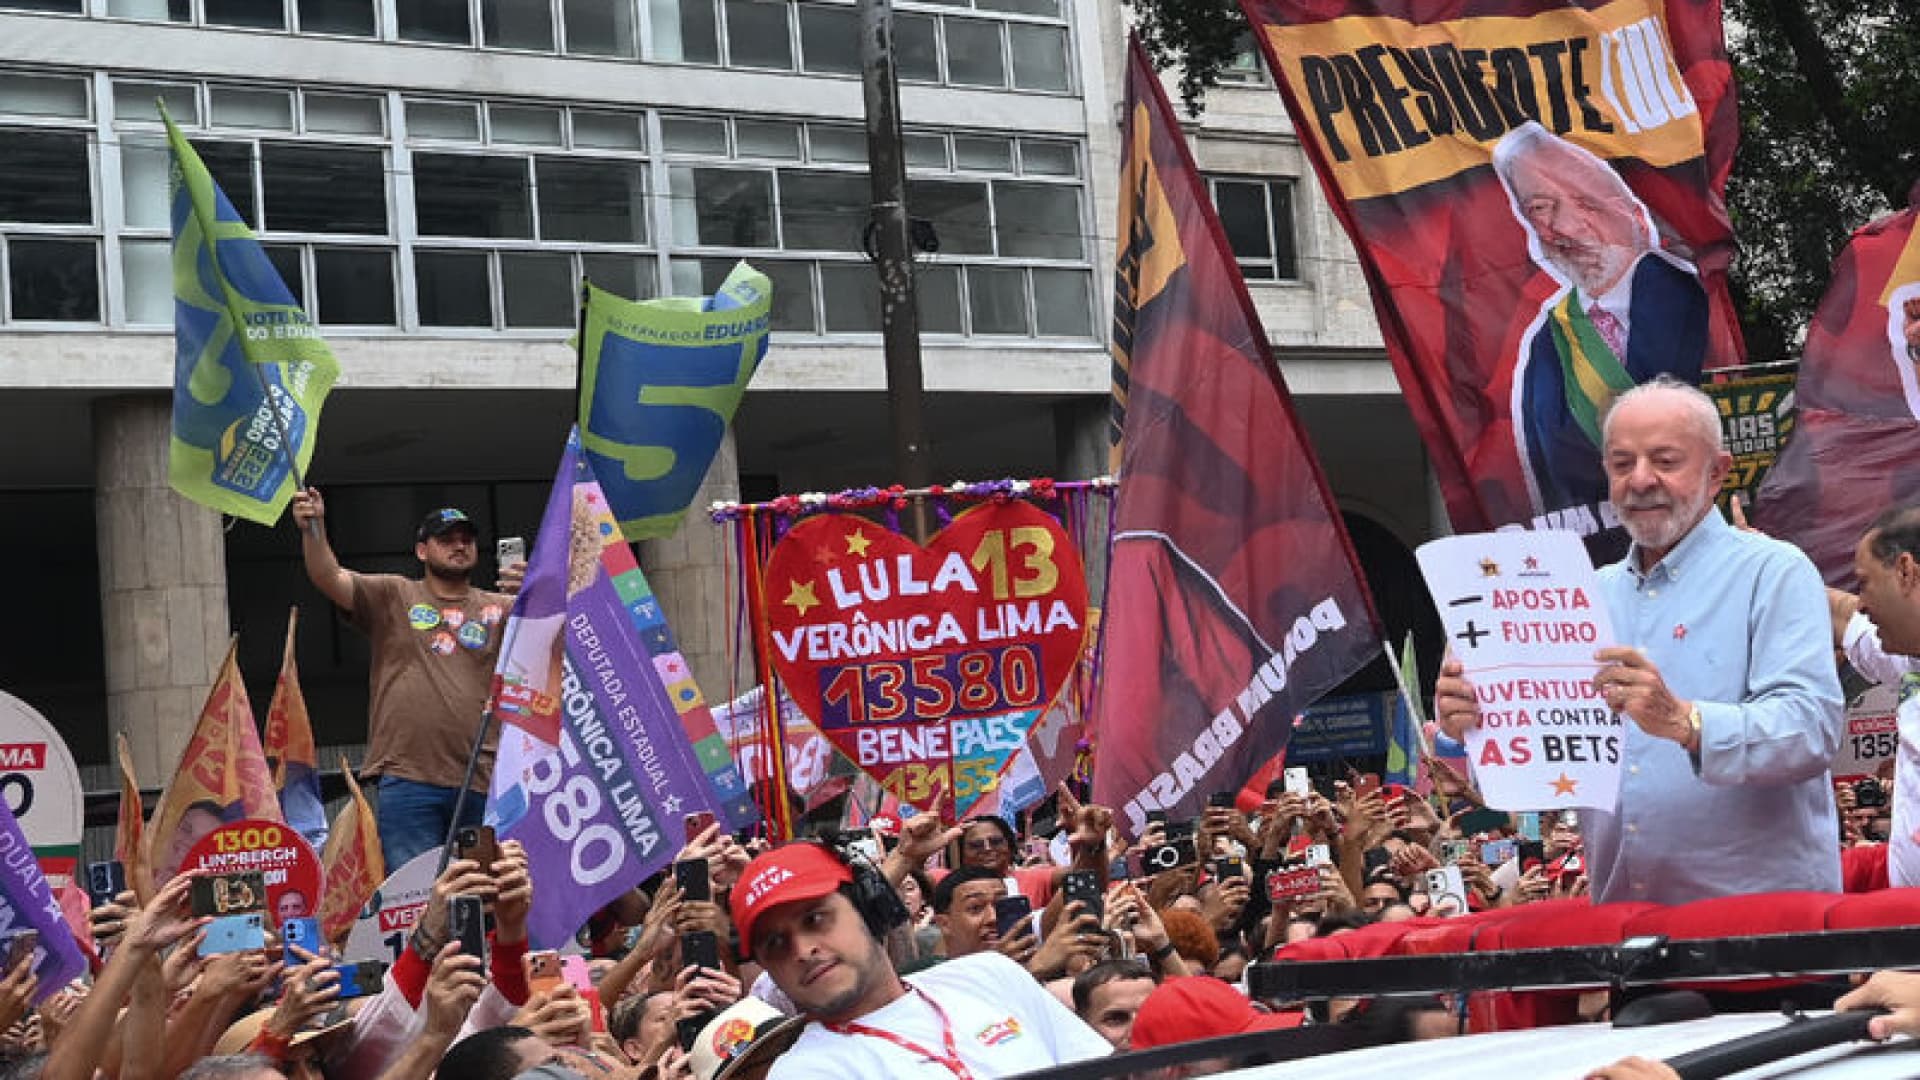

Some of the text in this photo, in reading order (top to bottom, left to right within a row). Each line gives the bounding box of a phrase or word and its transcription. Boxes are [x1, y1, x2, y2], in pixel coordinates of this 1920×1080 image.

[826, 527, 1059, 609] LULA 13
[1492, 588, 1591, 610] APOSTA
[772, 600, 1078, 661] VERÔNICA LIMA
[1502, 621, 1597, 644] FUTURO
[570, 613, 669, 796] DEPUTADA ESTADUAL
[823, 645, 1039, 722] 13580
[857, 718, 949, 766] BENÉ
[952, 711, 1026, 755] PAES
[1536, 707, 1622, 727] CONTRA
[1479, 734, 1619, 766] AS BETS
[213, 828, 282, 853] 1300
[610, 779, 661, 857] LIMA
